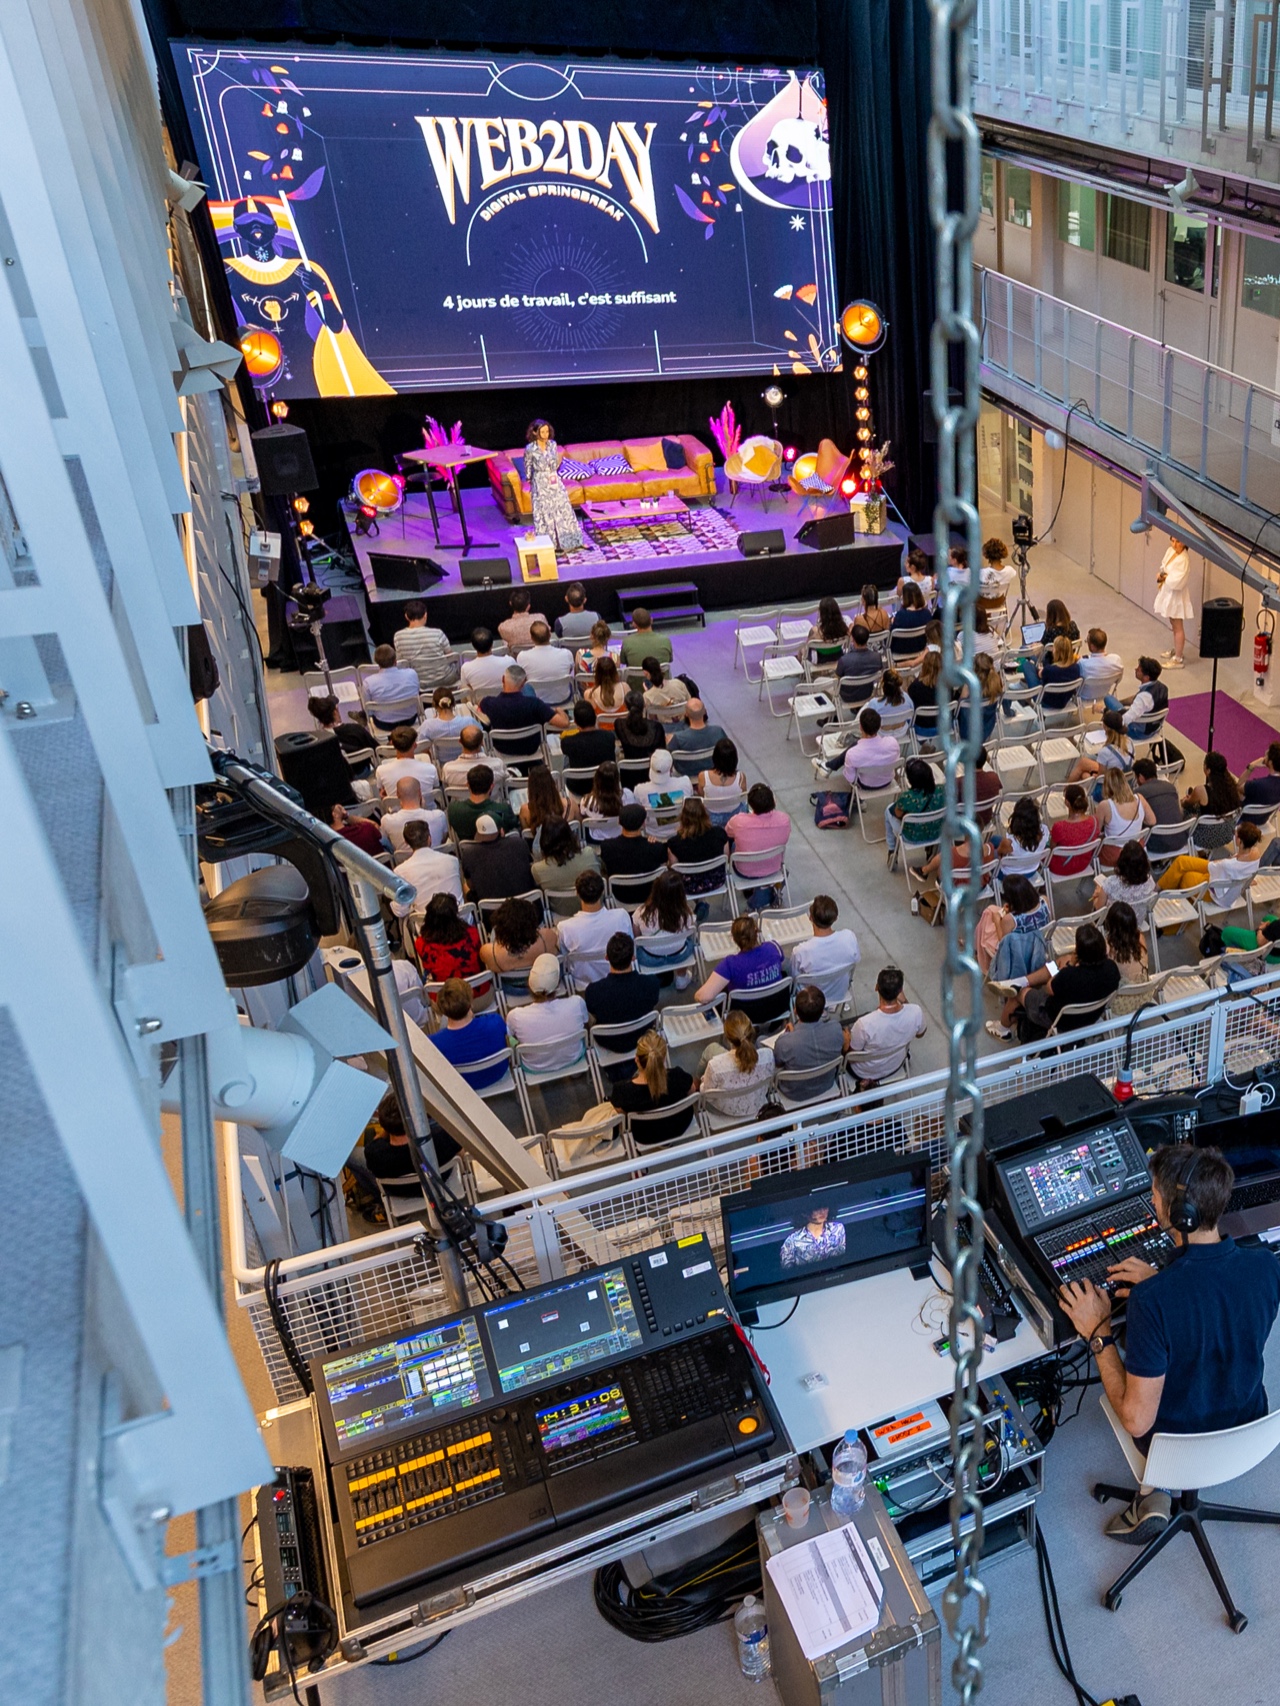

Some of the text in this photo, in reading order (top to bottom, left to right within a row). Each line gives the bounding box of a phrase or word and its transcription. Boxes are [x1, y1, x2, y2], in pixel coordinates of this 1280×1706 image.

[414, 116, 660, 234] WEB2DAY
[480, 184, 625, 221] DIGITAL SPRINGBREAK
[443, 291, 677, 312] 4 jours de travail, c'est suffisant
[543, 1388, 622, 1423] 14:31:08
